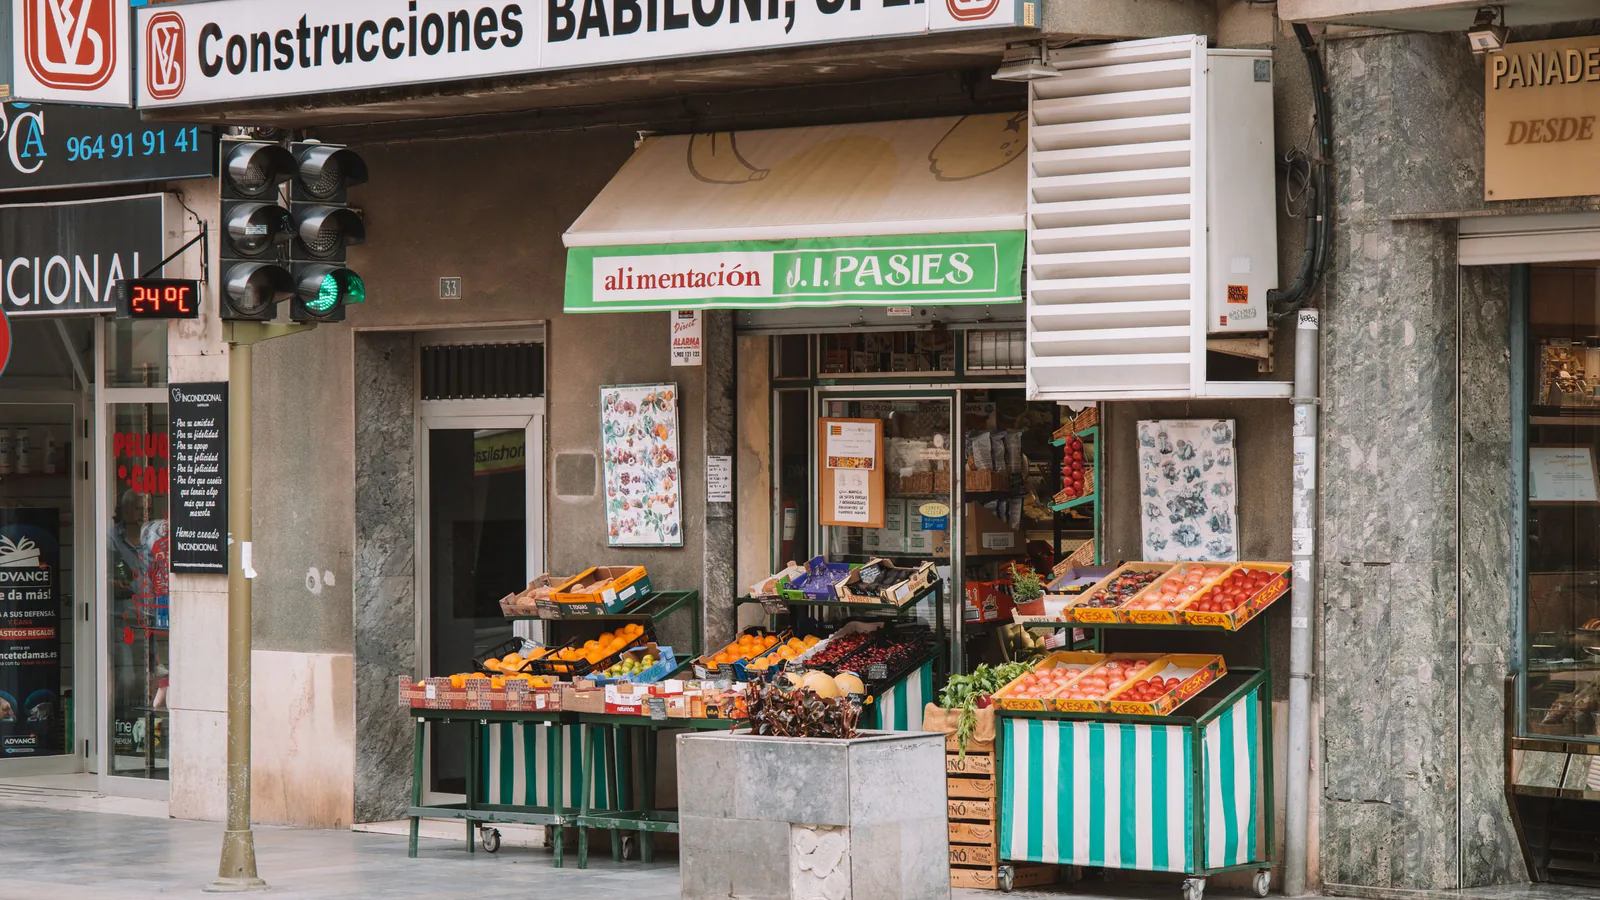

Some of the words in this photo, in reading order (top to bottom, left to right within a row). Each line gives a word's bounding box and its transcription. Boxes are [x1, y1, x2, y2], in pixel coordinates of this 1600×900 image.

[198, 2, 524, 78] Construcciones
[1493, 47, 1600, 89] PANADE
[1505, 115, 1596, 146] DESDE
[67, 135, 105, 162] 964
[110, 132, 134, 158] 91
[142, 129, 166, 156] 91
[174, 126, 199, 152] 41
[604, 263, 761, 291] alimentación
[834, 252, 974, 287] PASIES
[444, 280, 457, 297] 33
[673, 337, 699, 346] ALARMA
[182, 394, 222, 402] INCONDICIONAL
[176, 418, 186, 427] Por
[176, 429, 186, 438] Por
[176, 440, 186, 450] Por
[176, 452, 186, 461] Por
[176, 464, 186, 472] Por
[177, 475, 186, 484] Por
[188, 475, 196, 484] los
[180, 489, 190, 498] que
[206, 487, 218, 498] algo
[195, 501, 204, 509] que
[176, 527, 196, 538] Hemos
[196, 529, 220, 539] creado
[178, 542, 218, 552] INCONDICIONAL
[8, 590, 22, 600] da
[26, 588, 51, 600] más!
[1255, 578, 1285, 608] XESKA
[1078, 612, 1112, 621] XESKA
[1132, 612, 1168, 622] XESKA
[1188, 615, 1226, 625] XESKA
[28, 628, 54, 636] REGALOS
[1179, 671, 1210, 696] XESKA
[1003, 701, 1039, 710] XESKA
[1058, 702, 1094, 712] XESKA
[1114, 704, 1150, 715] XESKA
[949, 802, 966, 816] ÑÓ
[950, 848, 967, 862] ÑÓ
